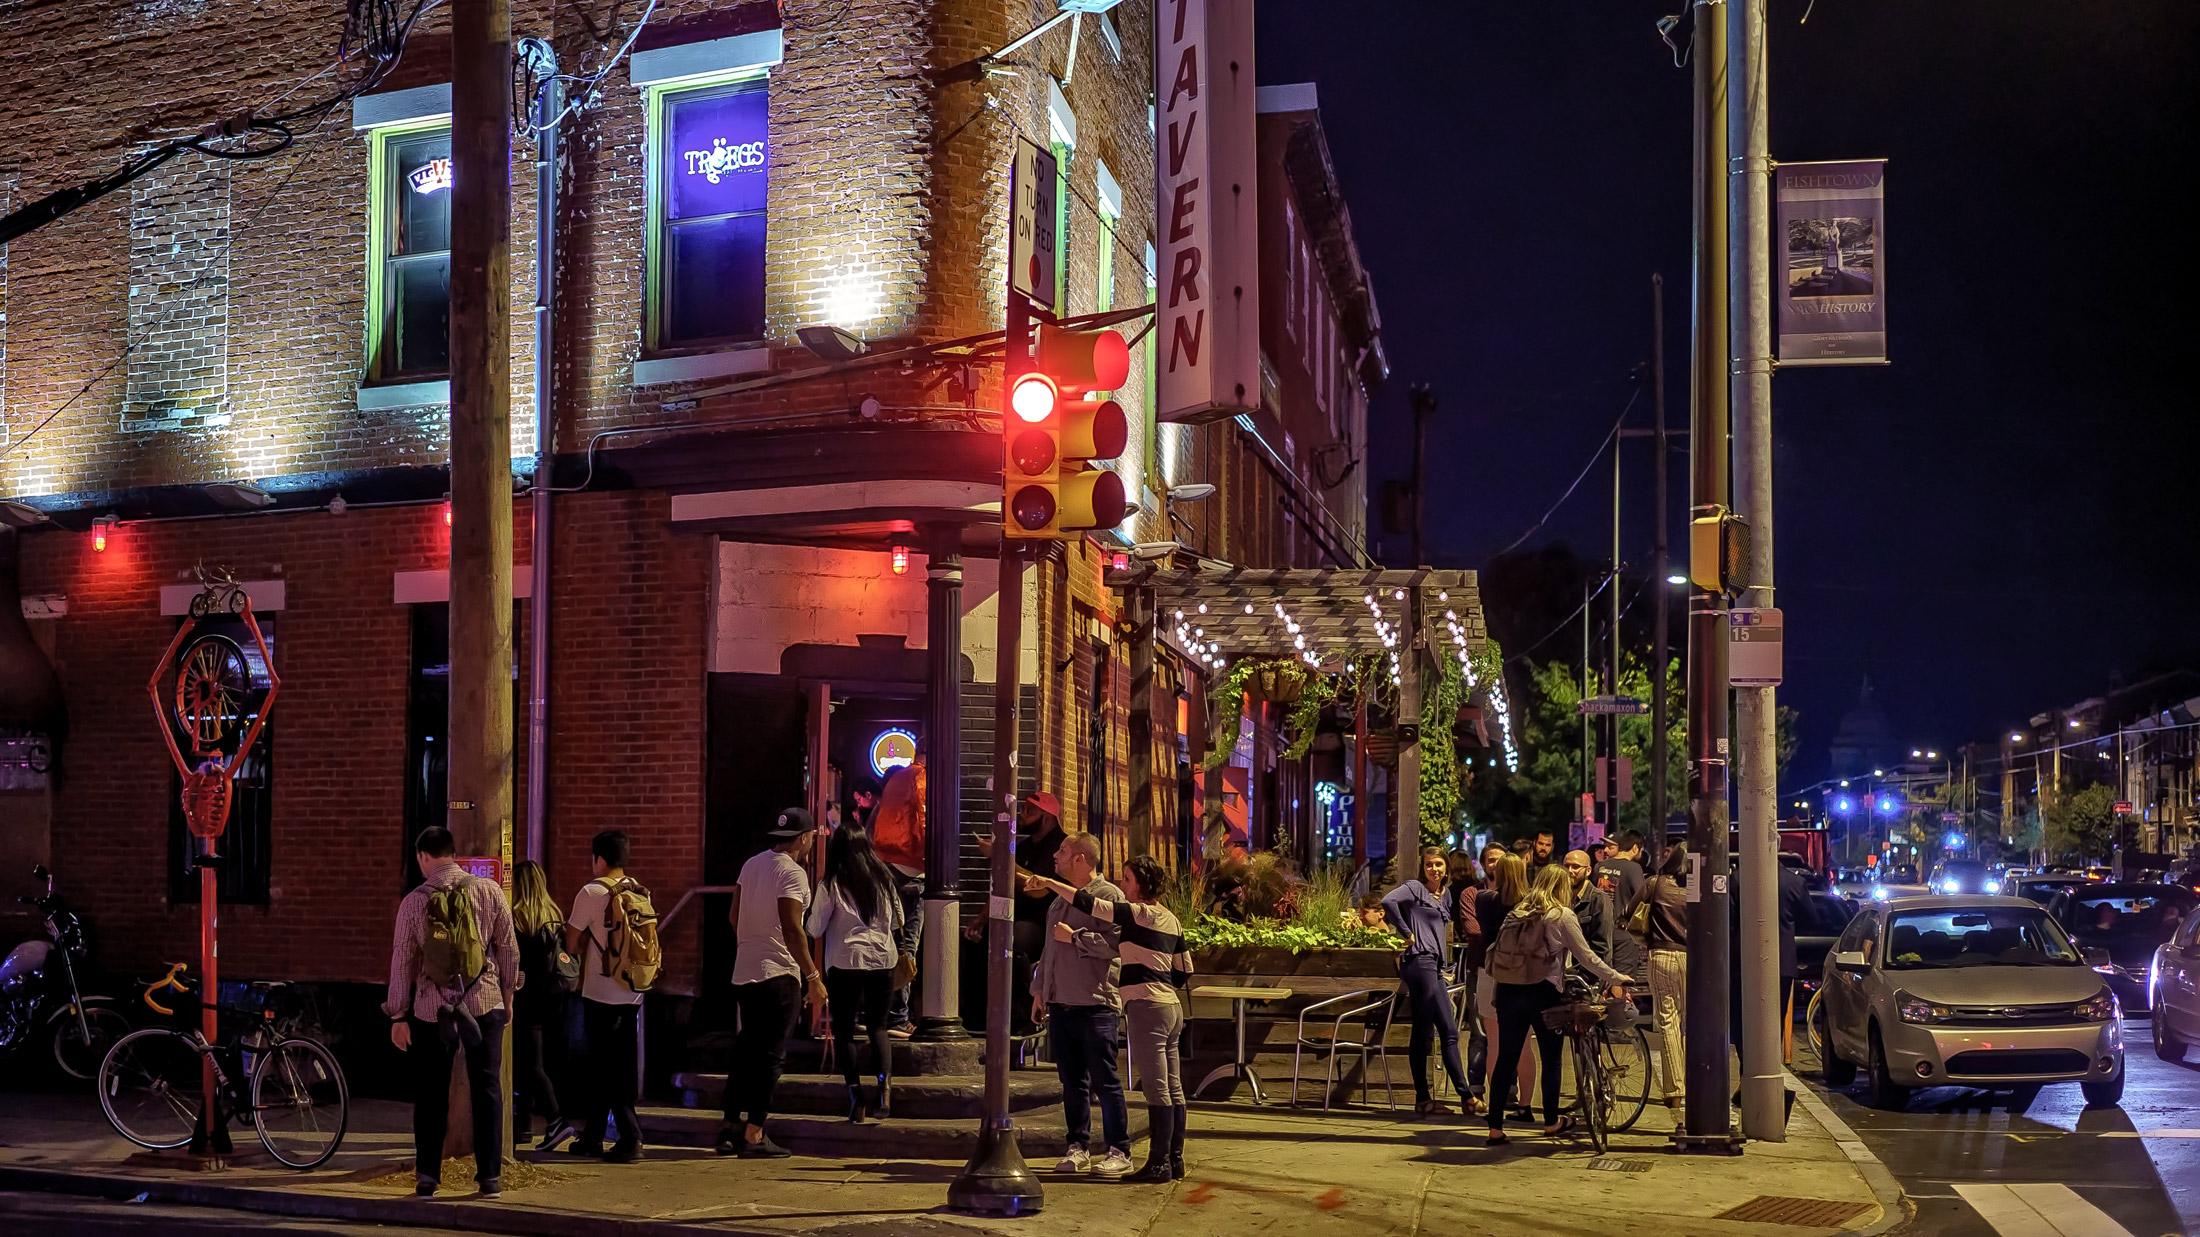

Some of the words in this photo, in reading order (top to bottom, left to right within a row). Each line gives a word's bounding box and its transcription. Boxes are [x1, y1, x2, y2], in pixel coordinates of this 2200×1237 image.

[1030, 155, 1045, 182] NO
[1167, 0, 1204, 373] TAVERN
[1785, 173, 1876, 189] FISHTOWN
[1025, 184, 1049, 219] TURN
[1019, 214, 1031, 242] ON
[1035, 221, 1052, 252] RED
[1820, 303, 1876, 315] HISTORY
[1732, 627, 1750, 642] 15
[1580, 702, 1636, 713] Shackamaxon
